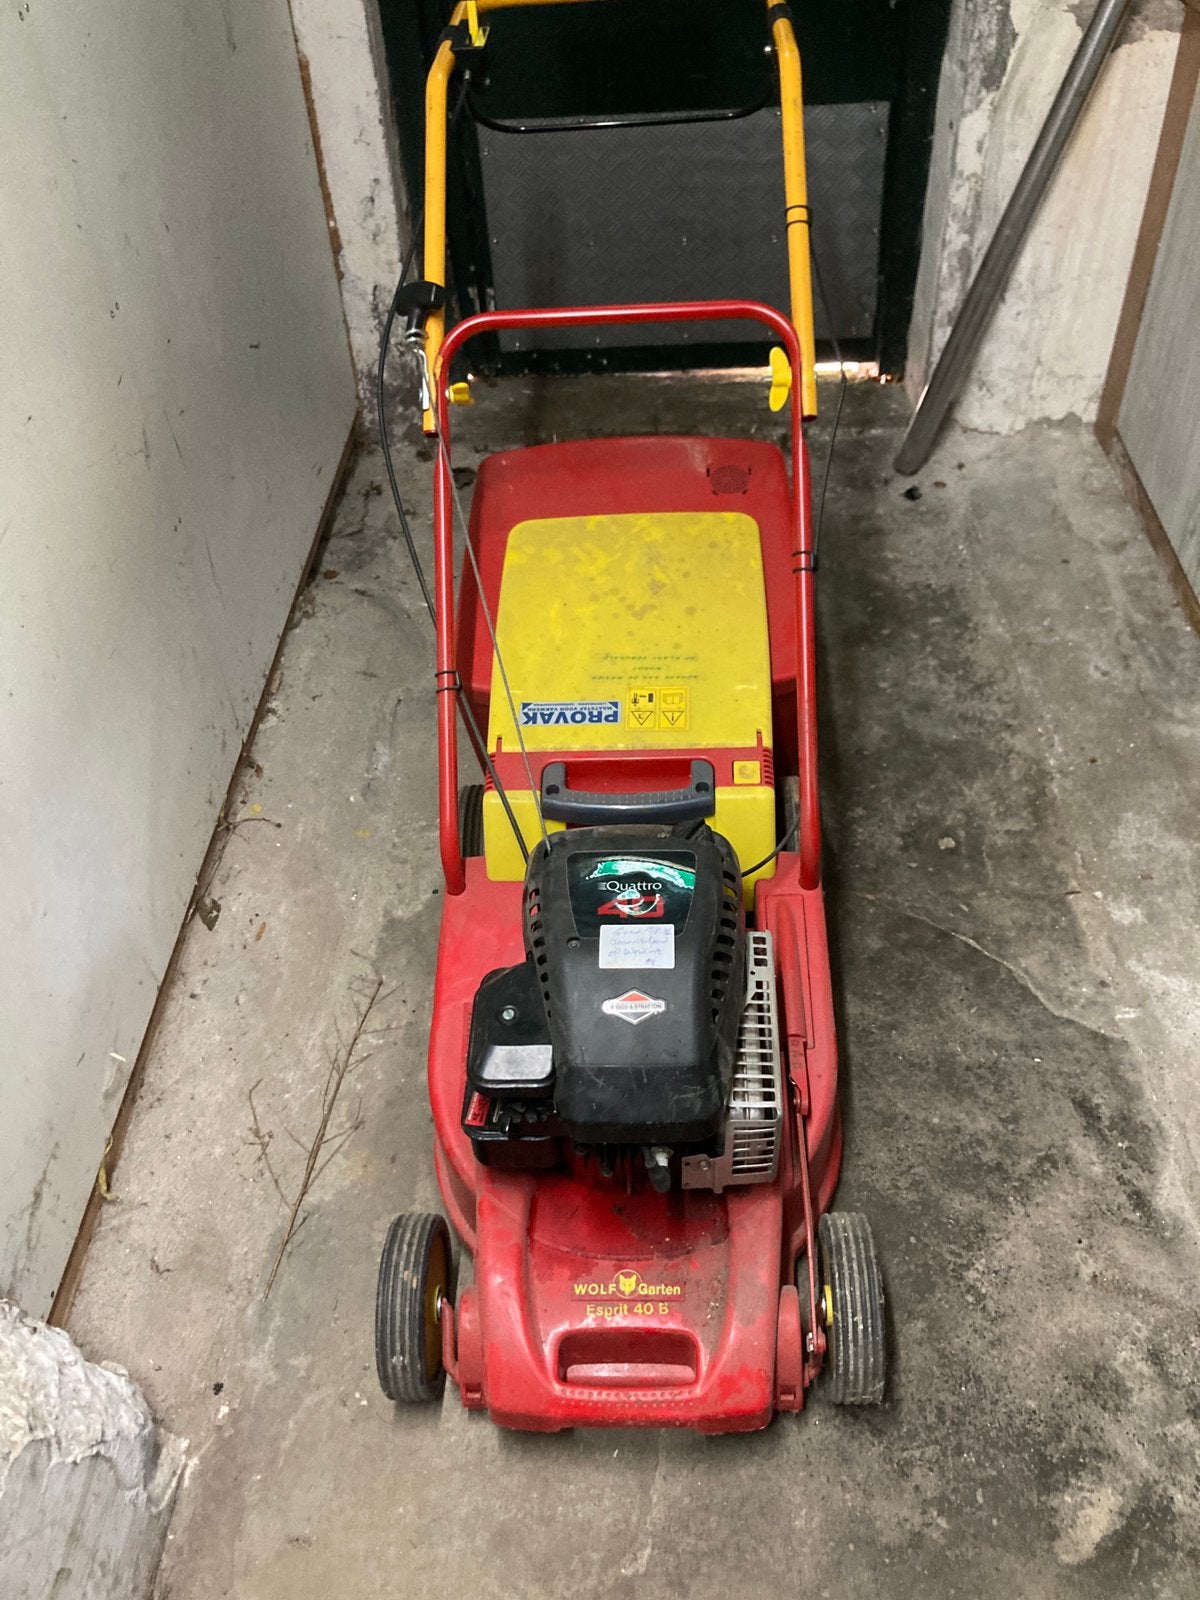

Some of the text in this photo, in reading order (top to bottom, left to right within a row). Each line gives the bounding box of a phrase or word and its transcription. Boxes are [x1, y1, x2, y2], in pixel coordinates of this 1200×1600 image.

[522, 710, 619, 725] PROVAK
[606, 880, 662, 893] Quattro
[574, 1283, 681, 1295] WOLF Garten
[587, 1302, 670, 1320] Esprit 40 B
